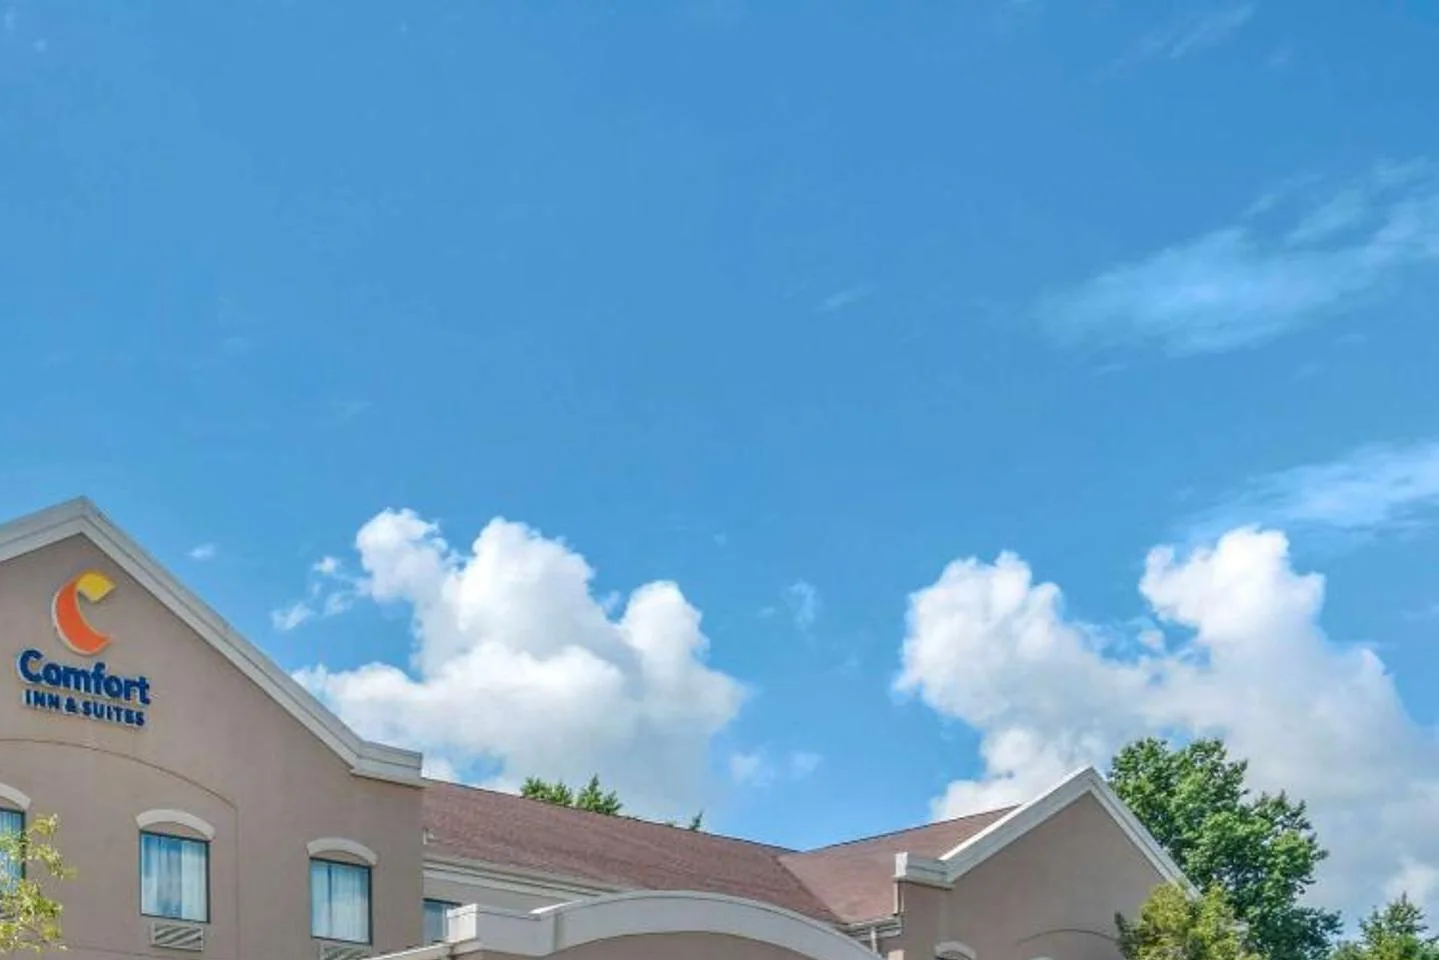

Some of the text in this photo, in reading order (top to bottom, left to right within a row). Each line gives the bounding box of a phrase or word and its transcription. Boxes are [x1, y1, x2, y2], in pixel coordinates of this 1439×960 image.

[18, 648, 151, 705] Comfort
[24, 689, 145, 728] INN & SUITES
